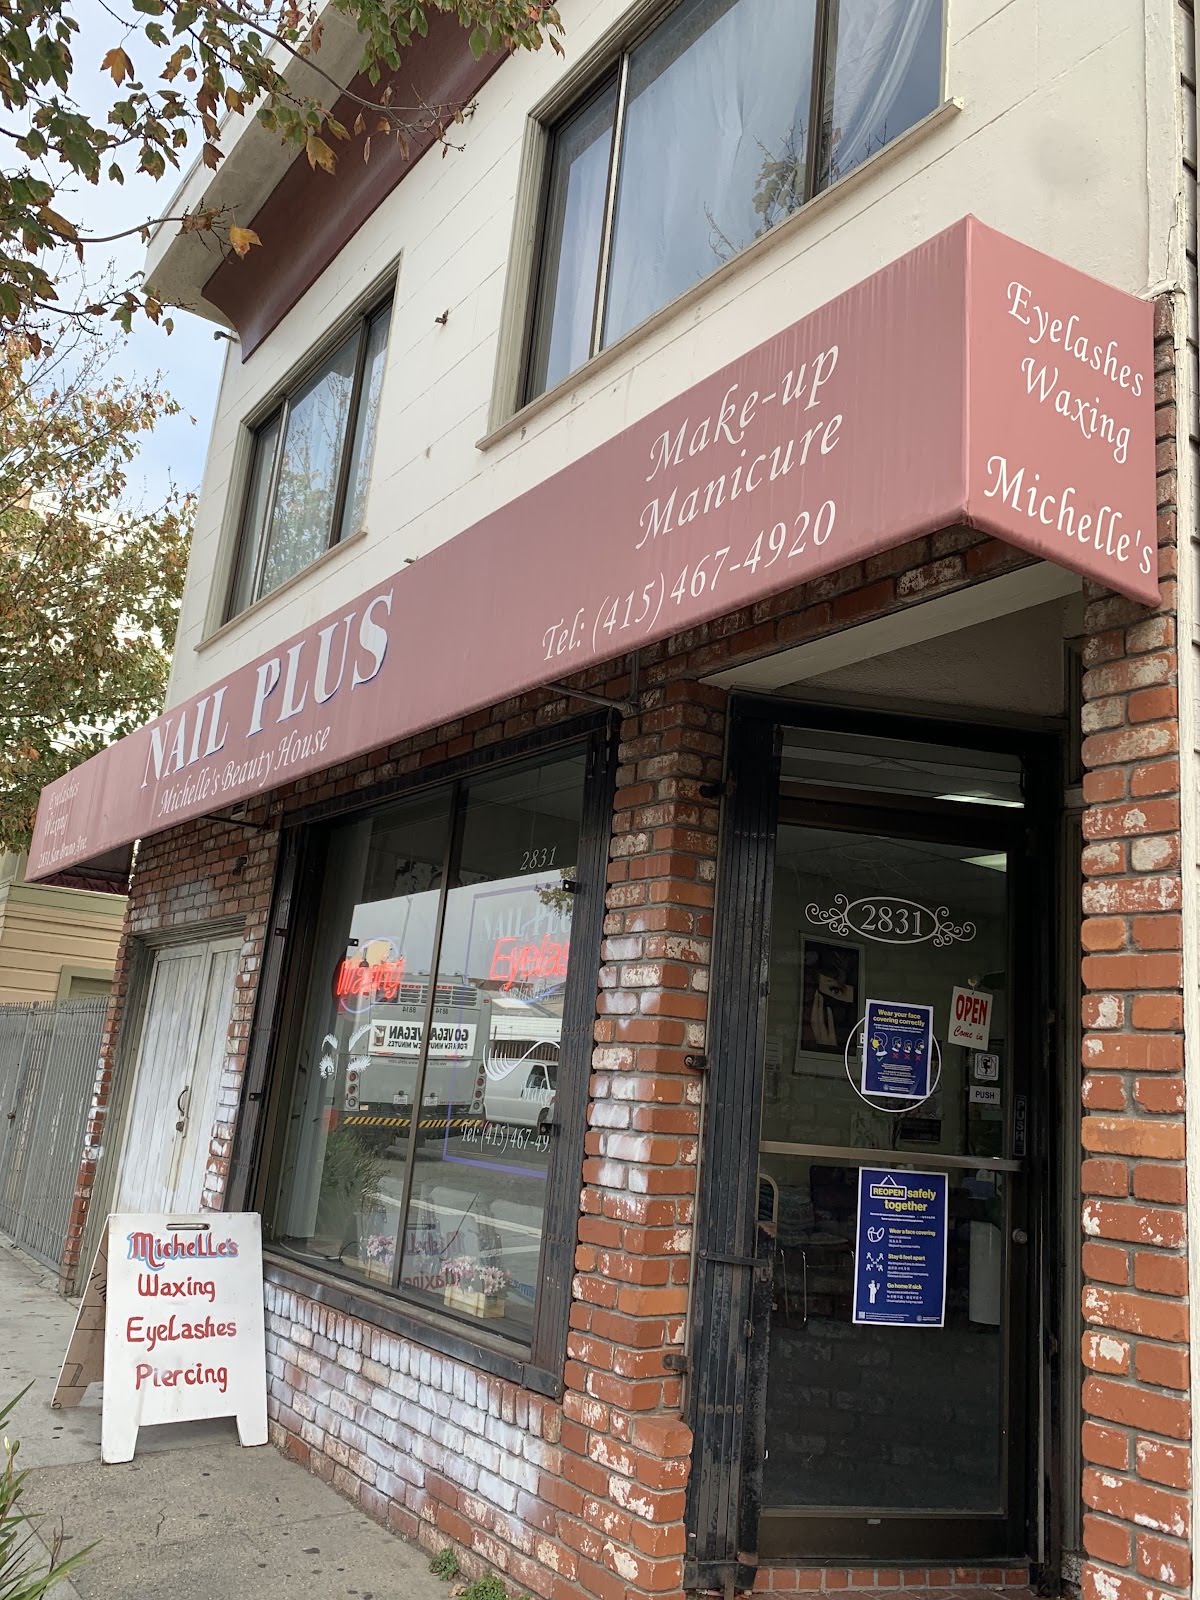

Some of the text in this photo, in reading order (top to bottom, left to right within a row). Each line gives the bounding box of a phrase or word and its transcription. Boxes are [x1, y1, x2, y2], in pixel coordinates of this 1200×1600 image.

[1007, 281, 1144, 397] Eyelashes
[646, 345, 839, 482] Make-up
[1021, 357, 1130, 464] Waxing
[635, 414, 843, 550] Manicure
[984, 456, 1153, 574] Michelle's
[543, 607, 585, 660] Tel:
[141, 588, 394, 789] NAIL PLUS
[158, 726, 331, 817] Michelle's Beauty House
[520, 846, 556, 870] 2831
[860, 905, 923, 936] 2831
[873, 1016, 925, 1027] covering correctly
[878, 1009, 893, 1017] Wear
[955, 994, 988, 1026] OPEN
[953, 1025, 983, 1040] Come in
[975, 1090, 994, 1099] PUSH
[873, 1187, 936, 1201] REOPEN safely
[884, 1199, 928, 1212] together
[137, 1273, 216, 1303] Waxing
[135, 1362, 228, 1393] Piercing
